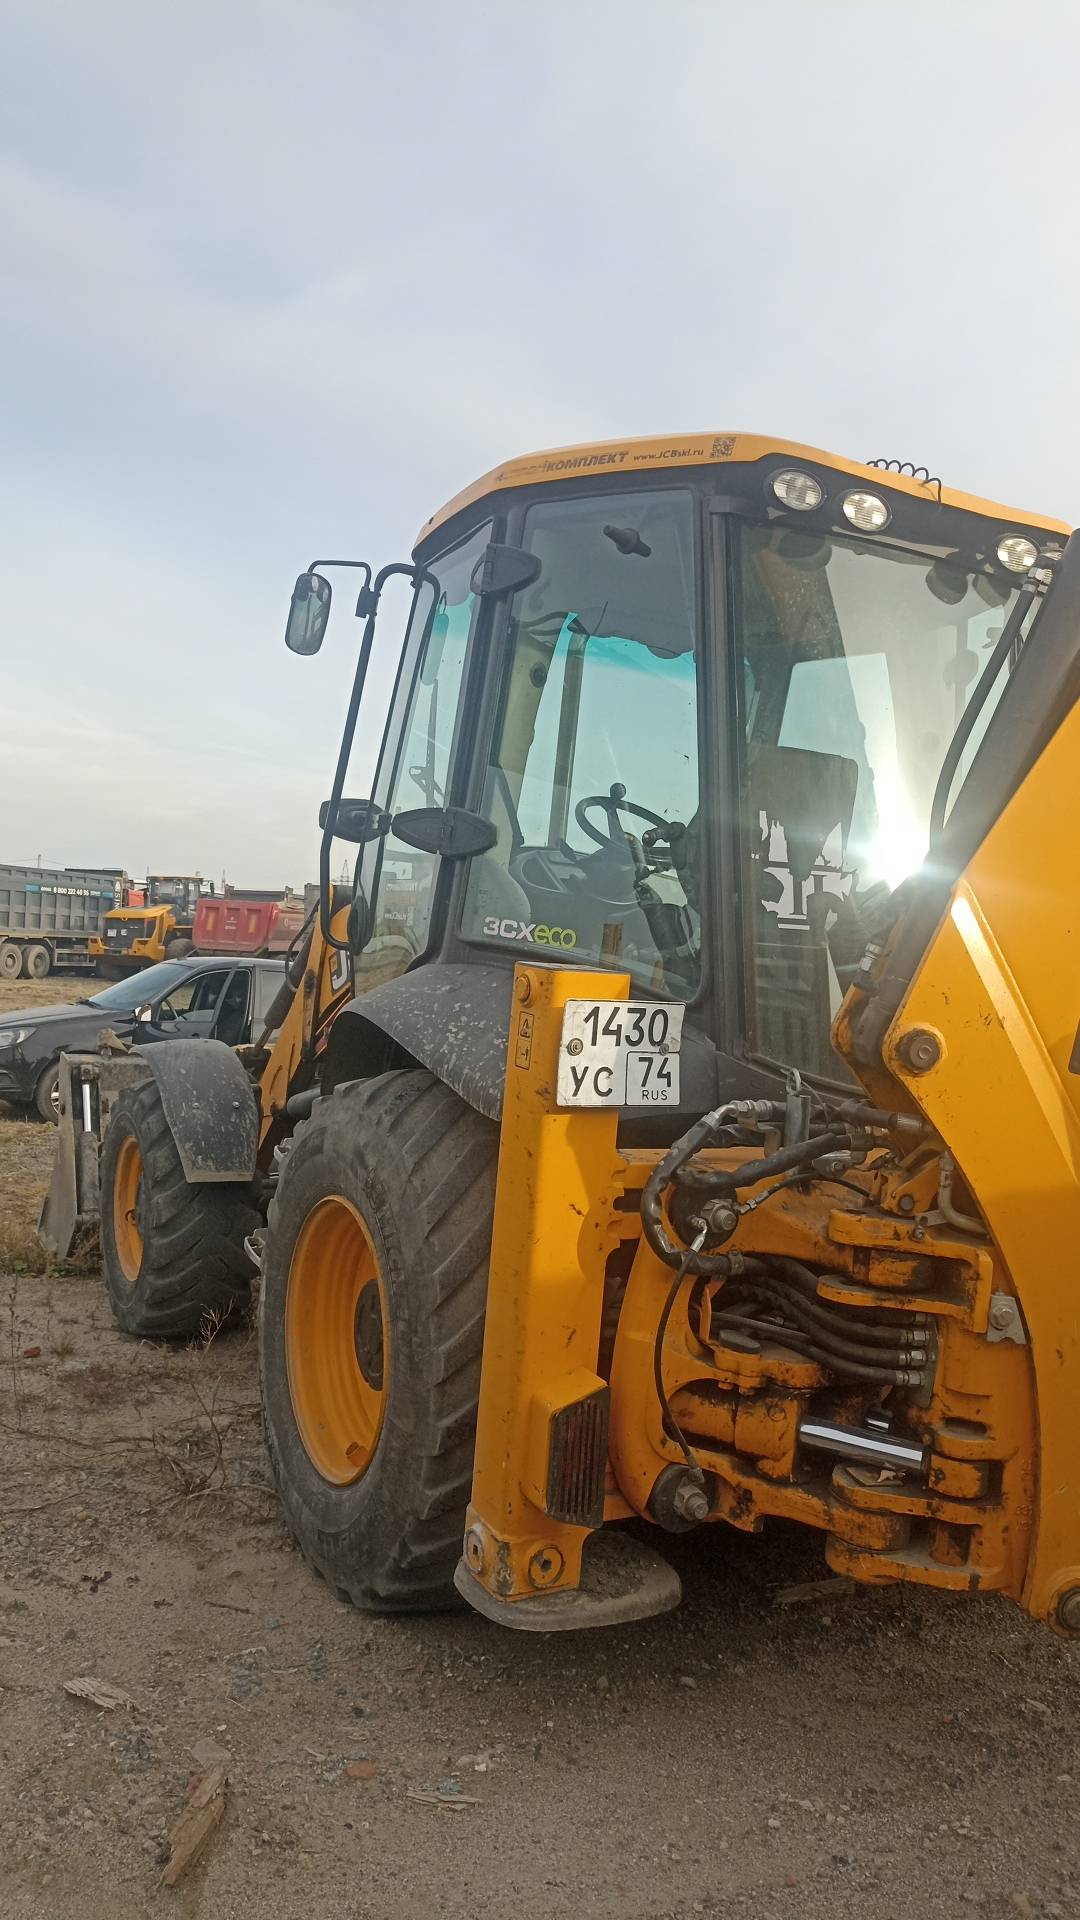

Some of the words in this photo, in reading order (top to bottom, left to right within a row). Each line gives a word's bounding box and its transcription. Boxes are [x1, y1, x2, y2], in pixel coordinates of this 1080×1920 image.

[583, 1006, 669, 1047] 1430
[570, 1066, 614, 1098] УС
[638, 1056, 672, 1088] 74
[641, 1089, 668, 1101] RUS
